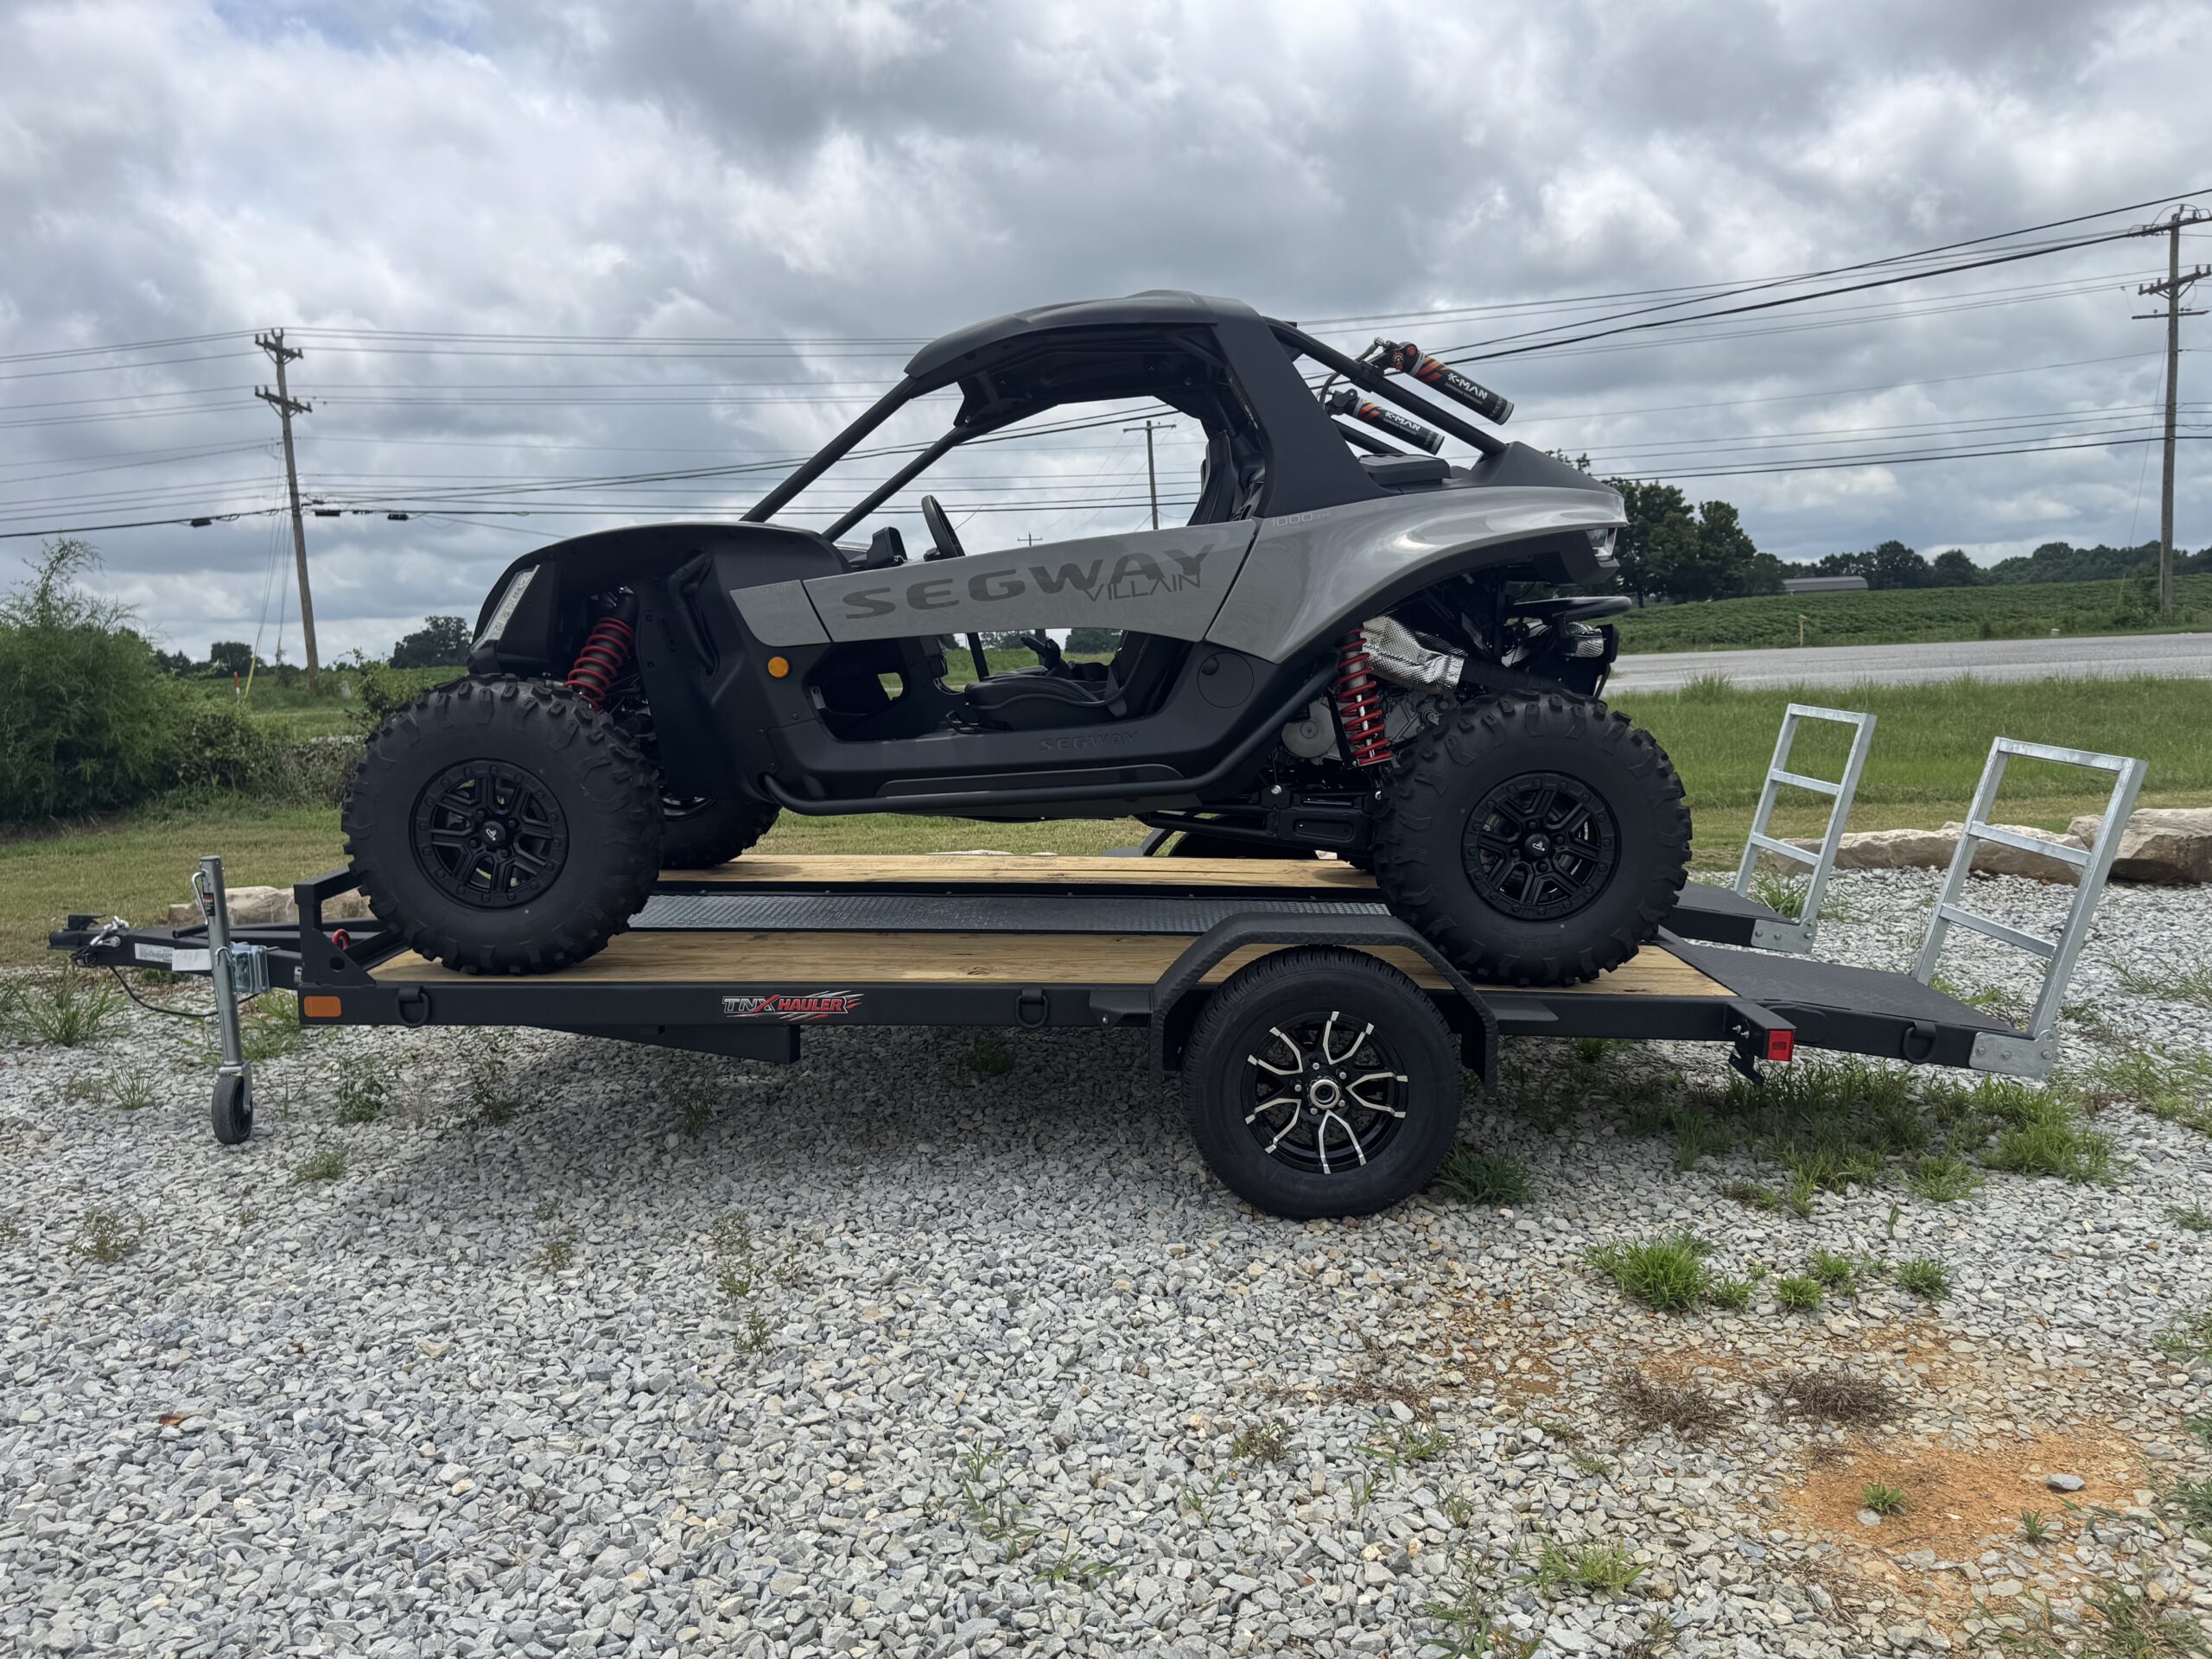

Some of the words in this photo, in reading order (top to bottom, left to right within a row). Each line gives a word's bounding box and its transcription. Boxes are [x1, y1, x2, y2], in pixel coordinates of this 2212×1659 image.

[1272, 512, 1313, 527] 1000
[842, 544, 1215, 620] SEGWAY
[1084, 570, 1201, 602] VILLAIN
[1037, 731, 1138, 751] SEGWAY
[723, 995, 779, 1013] TNX
[779, 998, 842, 1012] HAULER
